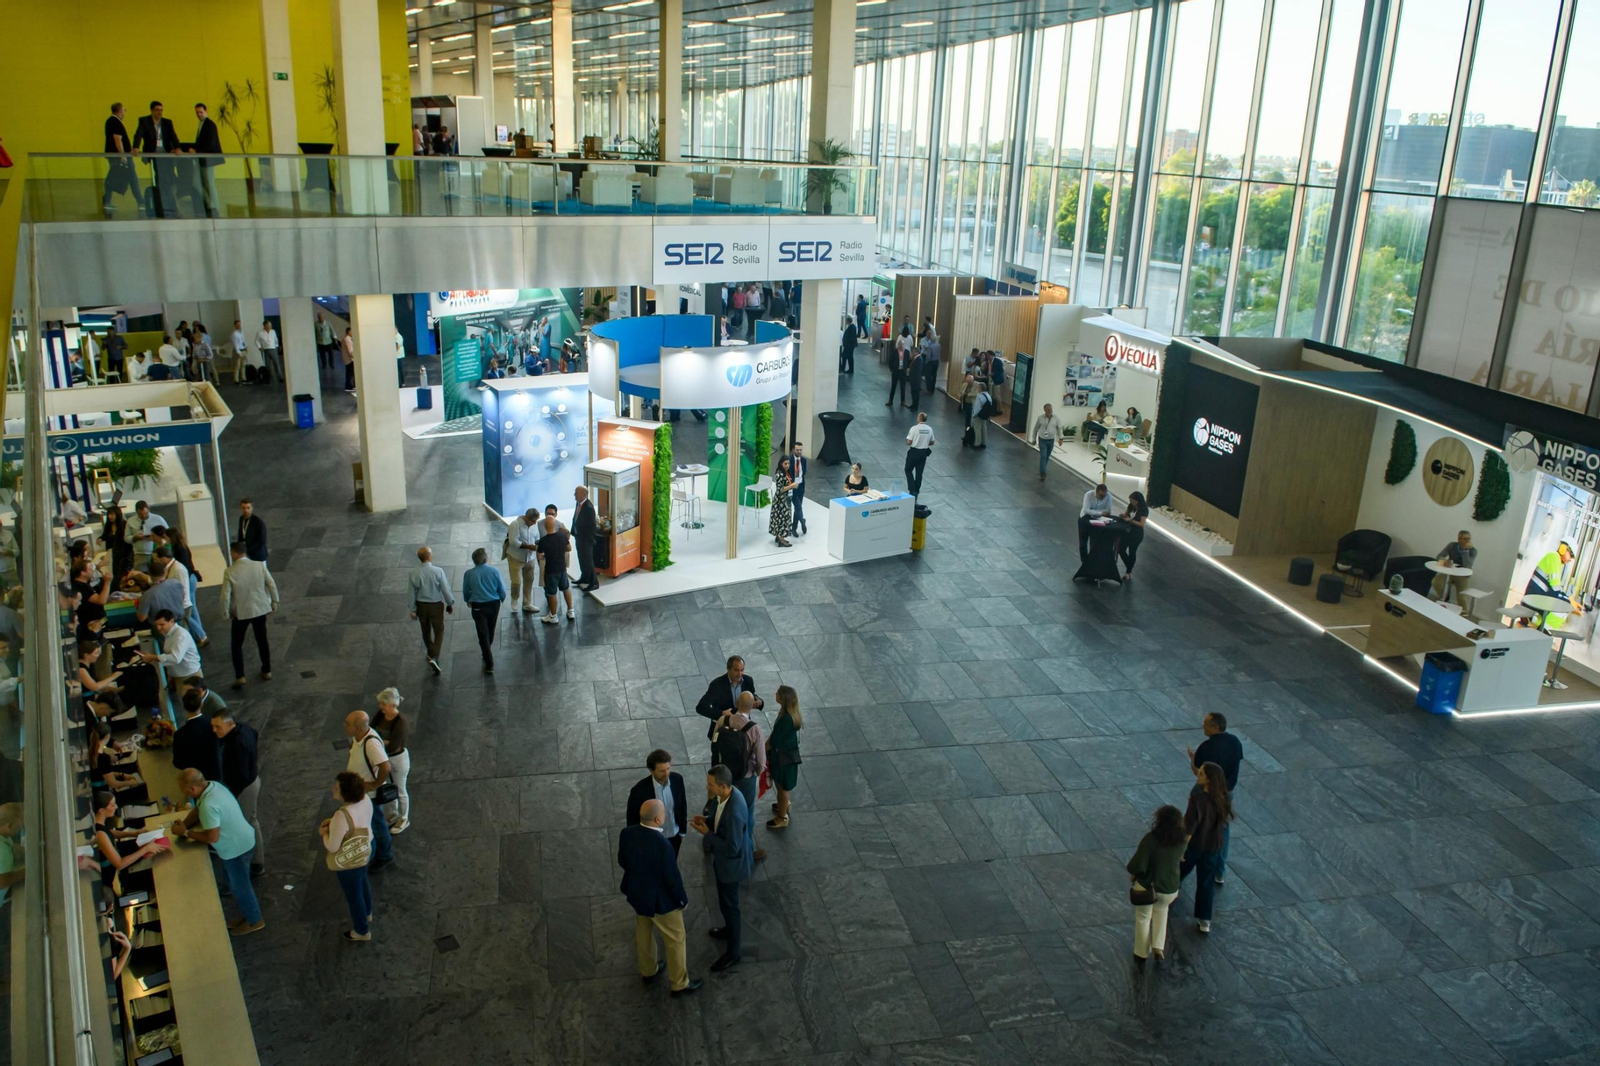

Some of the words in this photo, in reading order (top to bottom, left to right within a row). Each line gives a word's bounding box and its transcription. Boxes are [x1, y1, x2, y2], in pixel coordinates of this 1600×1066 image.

[732, 242, 758, 252] Radio
[778, 241, 833, 263] SER
[840, 240, 863, 250] Radio
[664, 242, 724, 266] SER
[732, 255, 760, 265] Sevilla
[839, 252, 865, 262] Sevilla
[1120, 344, 1157, 370] VEOLIA
[756, 376, 772, 385] Grupo
[83, 432, 160, 448] ILUNION
[1210, 422, 1242, 446] NIPPON
[1209, 435, 1234, 454] GASES
[1543, 439, 1600, 471] NIPPO
[1541, 459, 1597, 489] GASES
[342, 838, 362, 852] DKNY
